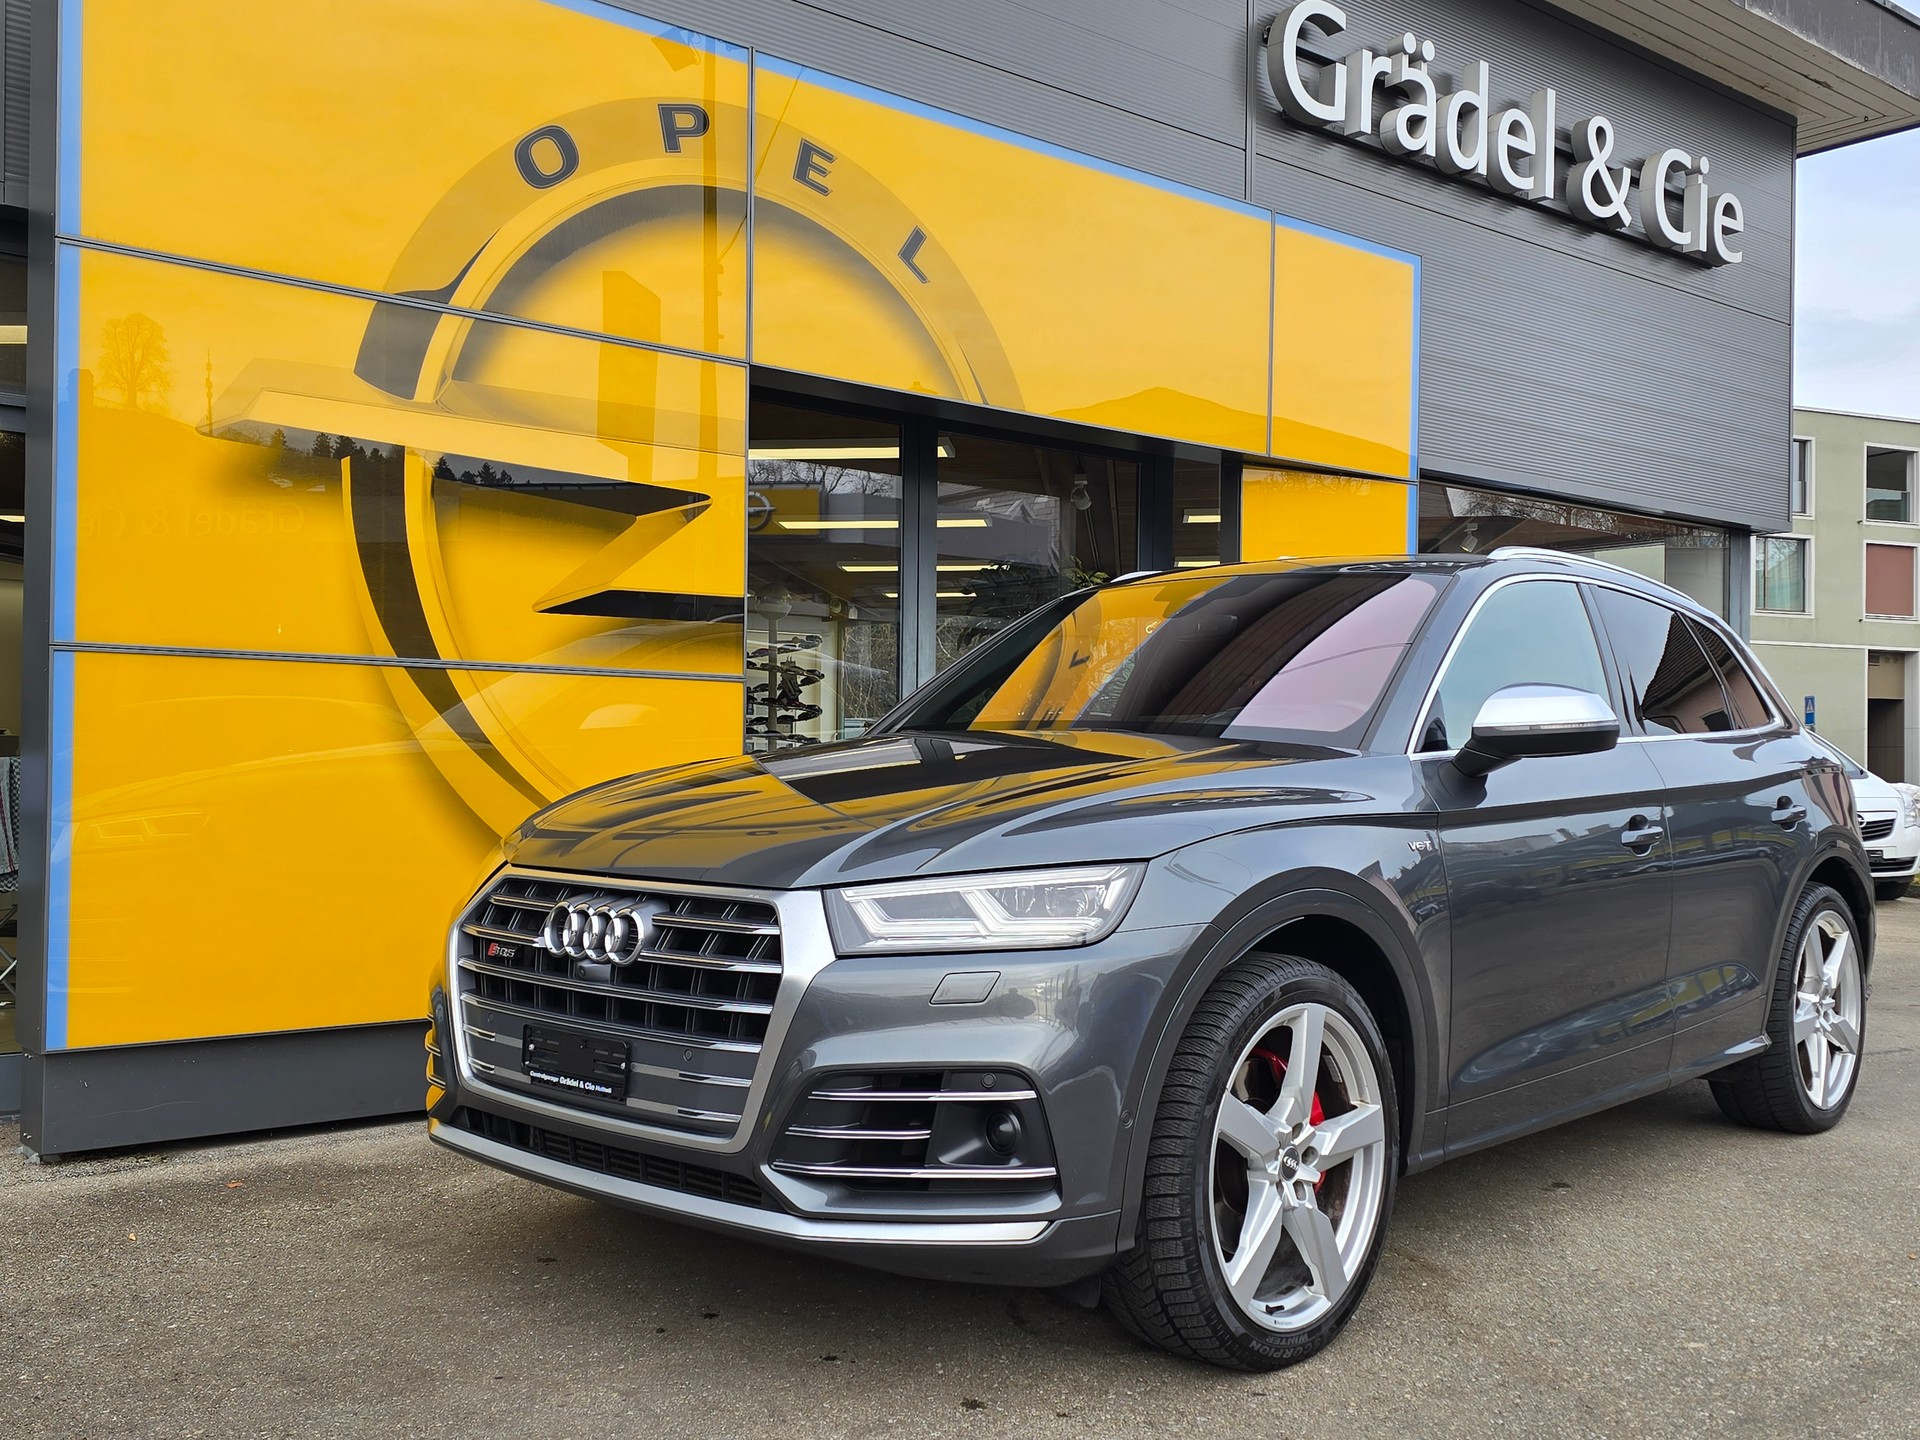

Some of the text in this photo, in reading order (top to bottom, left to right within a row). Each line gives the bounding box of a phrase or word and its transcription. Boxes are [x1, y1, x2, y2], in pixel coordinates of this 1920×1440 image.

[1275, 0, 1745, 265] Grädel & Cie
[514, 103, 931, 284] OPEL
[488, 942, 516, 958] SQ5
[1249, 1336, 1322, 1359] SCORPION
[1266, 1332, 1310, 1346] WINTER
